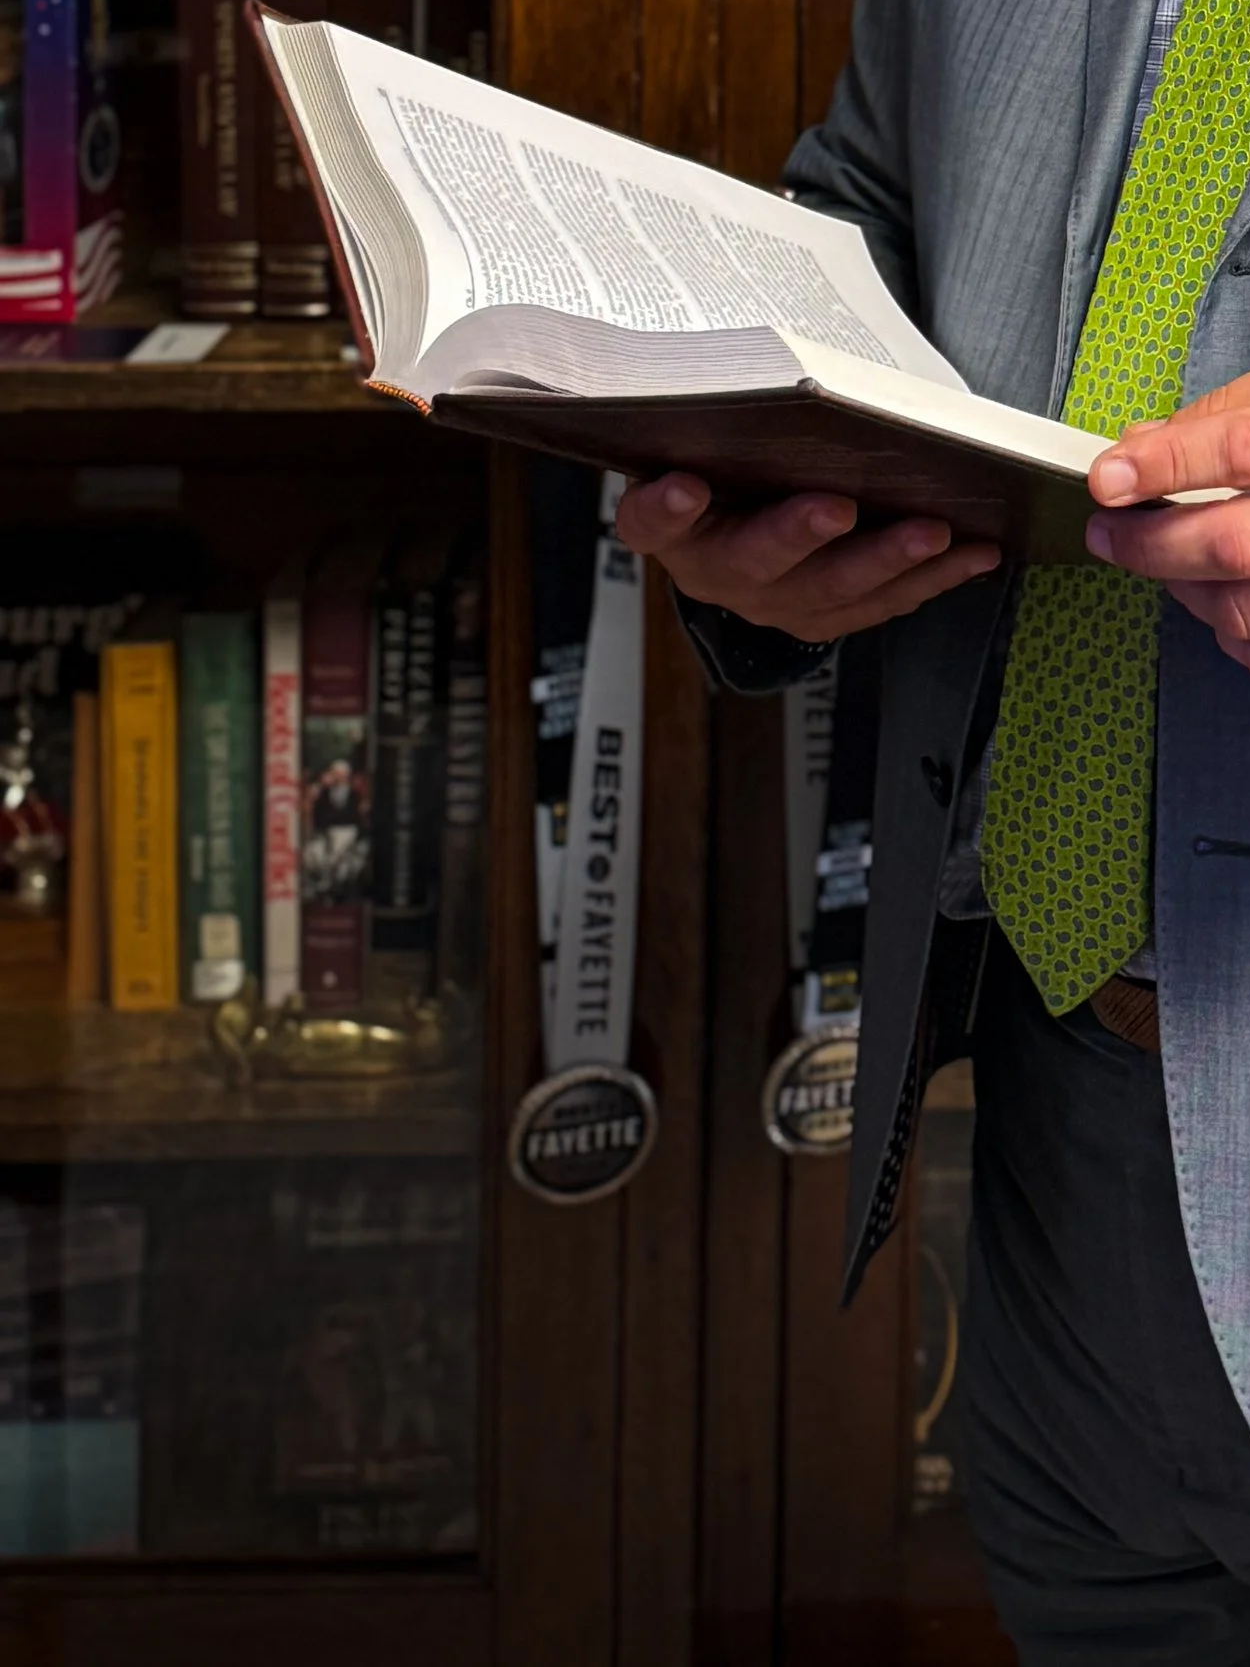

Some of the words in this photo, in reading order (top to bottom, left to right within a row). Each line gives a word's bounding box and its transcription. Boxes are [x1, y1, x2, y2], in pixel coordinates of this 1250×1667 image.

[267, 673, 300, 755] Roots
[806, 668, 837, 787] AYETTE
[588, 726, 624, 854] BEST
[575, 891, 616, 1037] FAYETTE
[527, 1114, 642, 1163] FAYETTE
[779, 1080, 856, 1118] FAYET
